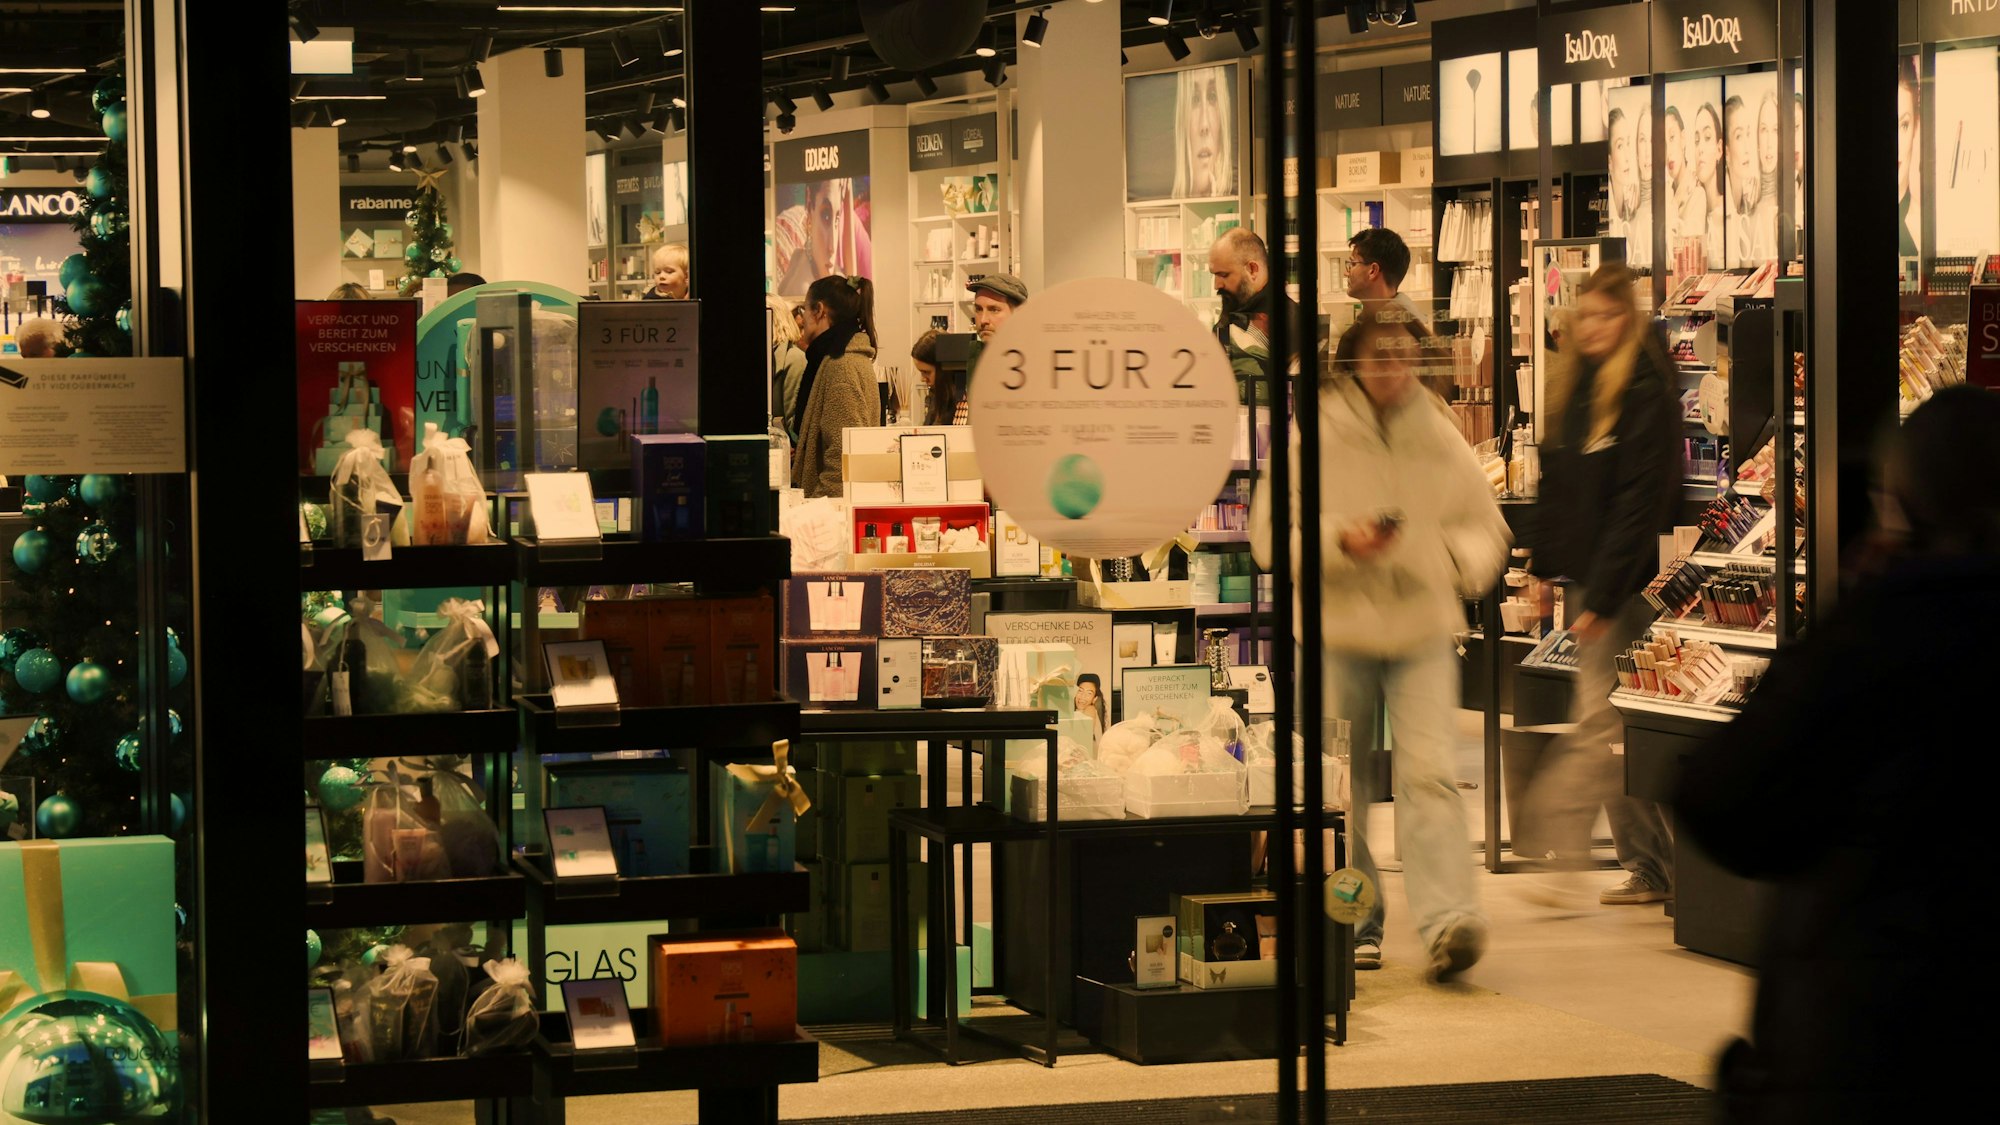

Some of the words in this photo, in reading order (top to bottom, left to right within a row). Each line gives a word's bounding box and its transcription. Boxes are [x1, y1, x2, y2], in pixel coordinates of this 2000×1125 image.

[1403, 85, 1431, 102] NATURE
[1335, 93, 1360, 109] NATURE
[916, 133, 943, 153] REDKEN
[805, 145, 839, 172] DOUGLAS
[350, 197, 412, 210] rabanne
[307, 315, 368, 325] VERPACKT
[372, 315, 400, 325] UND
[318, 328, 358, 338] BEREIT
[362, 328, 388, 338] ZUM
[602, 328, 612, 344] 3
[620, 324, 659, 344] FÜR
[666, 328, 677, 342] 2
[309, 342, 397, 352] VERSCHENKEN
[1002, 348, 1027, 390] 3
[1050, 339, 1150, 390] FÜR
[70, 373, 127, 381] PARFÜMERIE
[50, 382, 136, 390] VIDEOÜBERWACHT
[1004, 621, 1070, 631] VERSCHENKE
[1073, 620, 1094, 630] DAS
[1148, 674, 1186, 683] VERPACKT
[1155, 684, 1180, 692] BEREIT
[1140, 692, 1194, 701] VERSCHENKEN
[545, 948, 637, 985] GLAS
[104, 1046, 181, 1061] DOUGLAS
